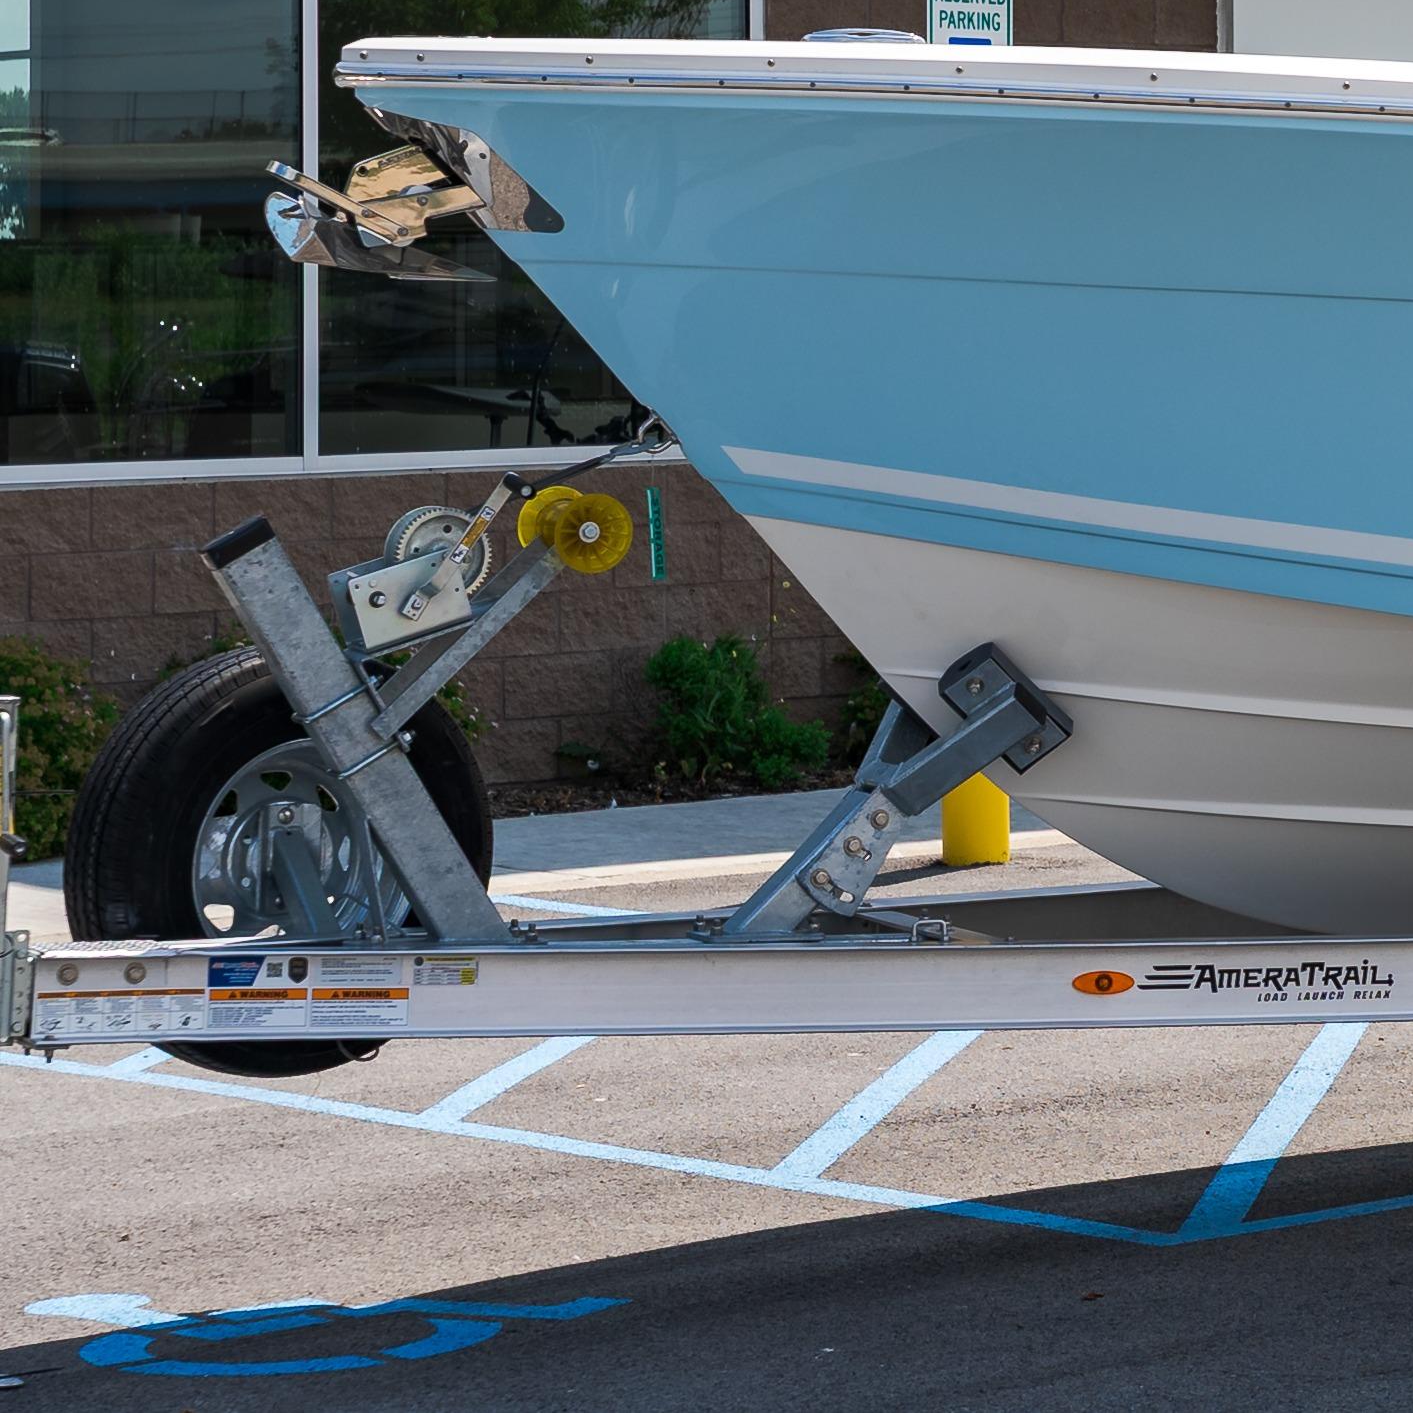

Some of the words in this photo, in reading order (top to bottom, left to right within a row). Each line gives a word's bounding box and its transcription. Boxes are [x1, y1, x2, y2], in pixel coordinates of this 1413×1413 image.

[939, 9, 1001, 32] PARKING
[240, 990, 288, 999] WARNING
[343, 990, 390, 998] WARNING
[1257, 992, 1288, 1002] LOAD
[1297, 991, 1344, 1001] LAUNCH
[1353, 989, 1392, 1000] RELAX
